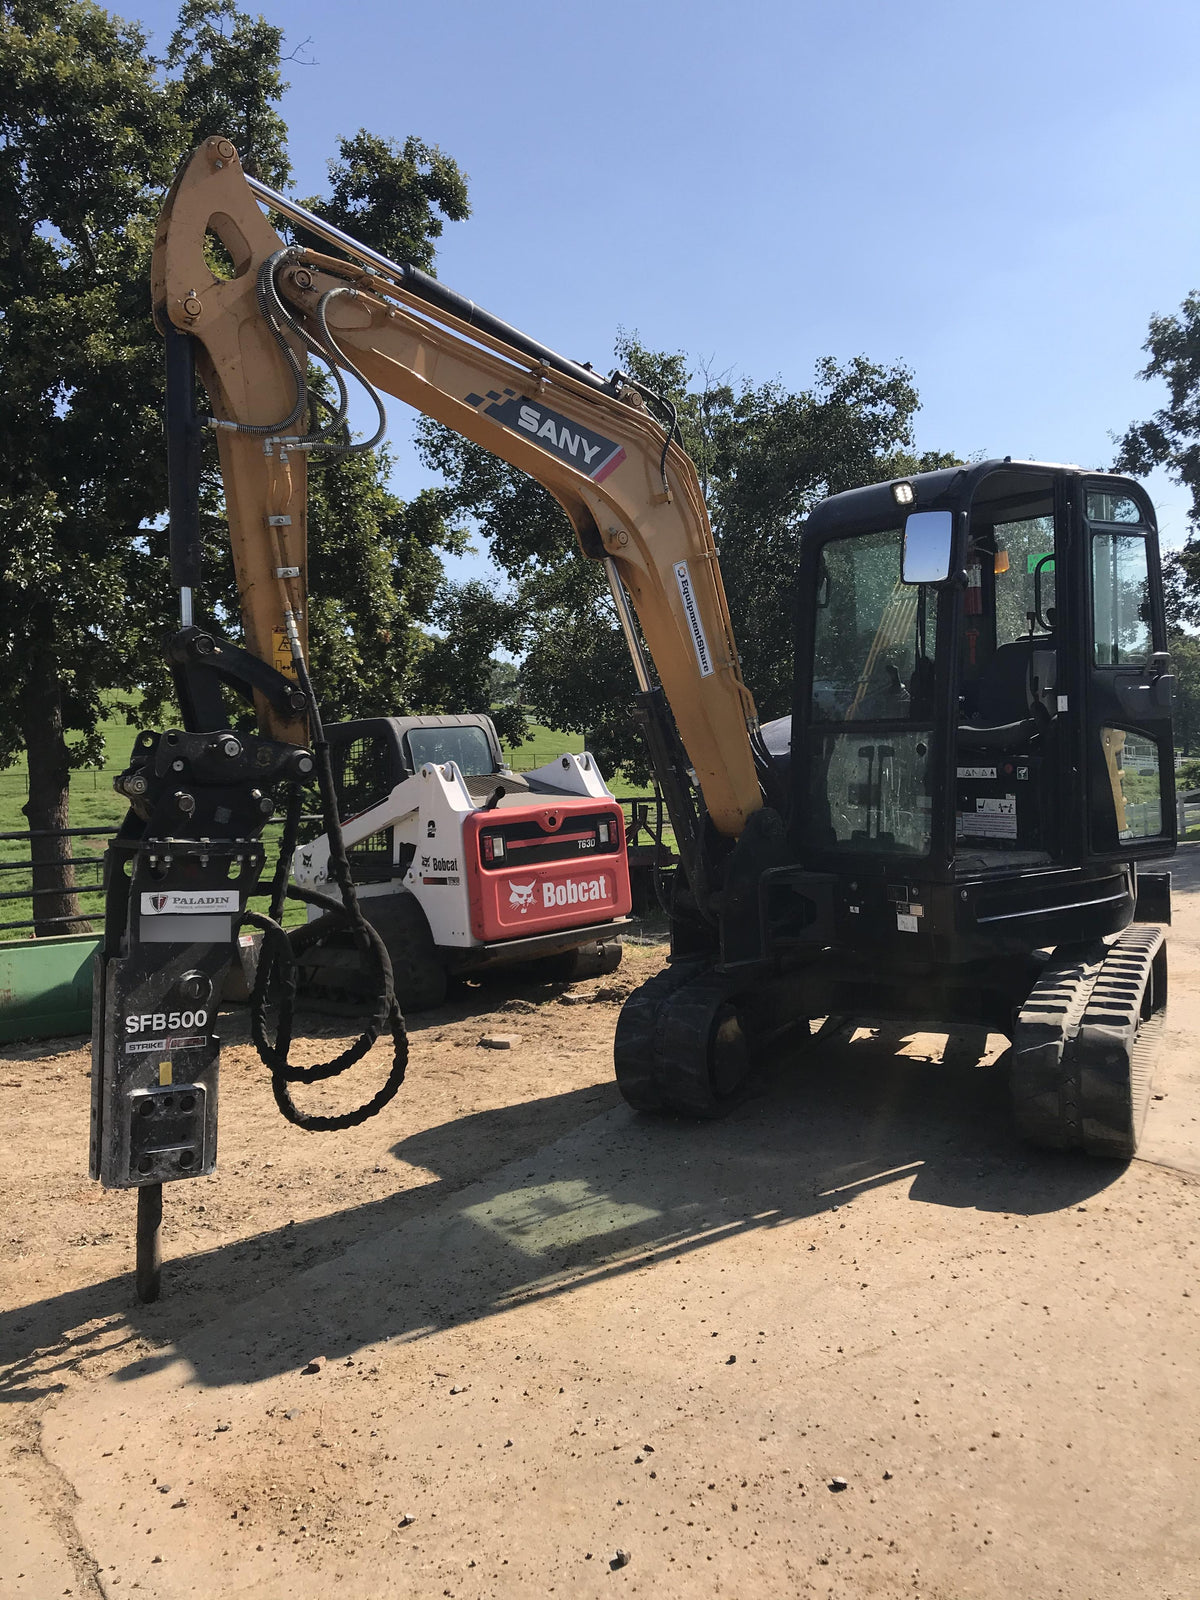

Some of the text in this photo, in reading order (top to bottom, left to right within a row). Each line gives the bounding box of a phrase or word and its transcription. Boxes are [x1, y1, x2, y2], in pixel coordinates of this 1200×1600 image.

[517, 405, 601, 465] SANY
[681, 579, 709, 672] EquipmentShare
[577, 838, 596, 849] T630
[432, 857, 458, 872] Bobcat
[172, 896, 229, 905] PALADIN
[542, 875, 607, 908] Bobcat
[125, 1009, 208, 1034] SFB500
[128, 1042, 164, 1051] STRIKE
